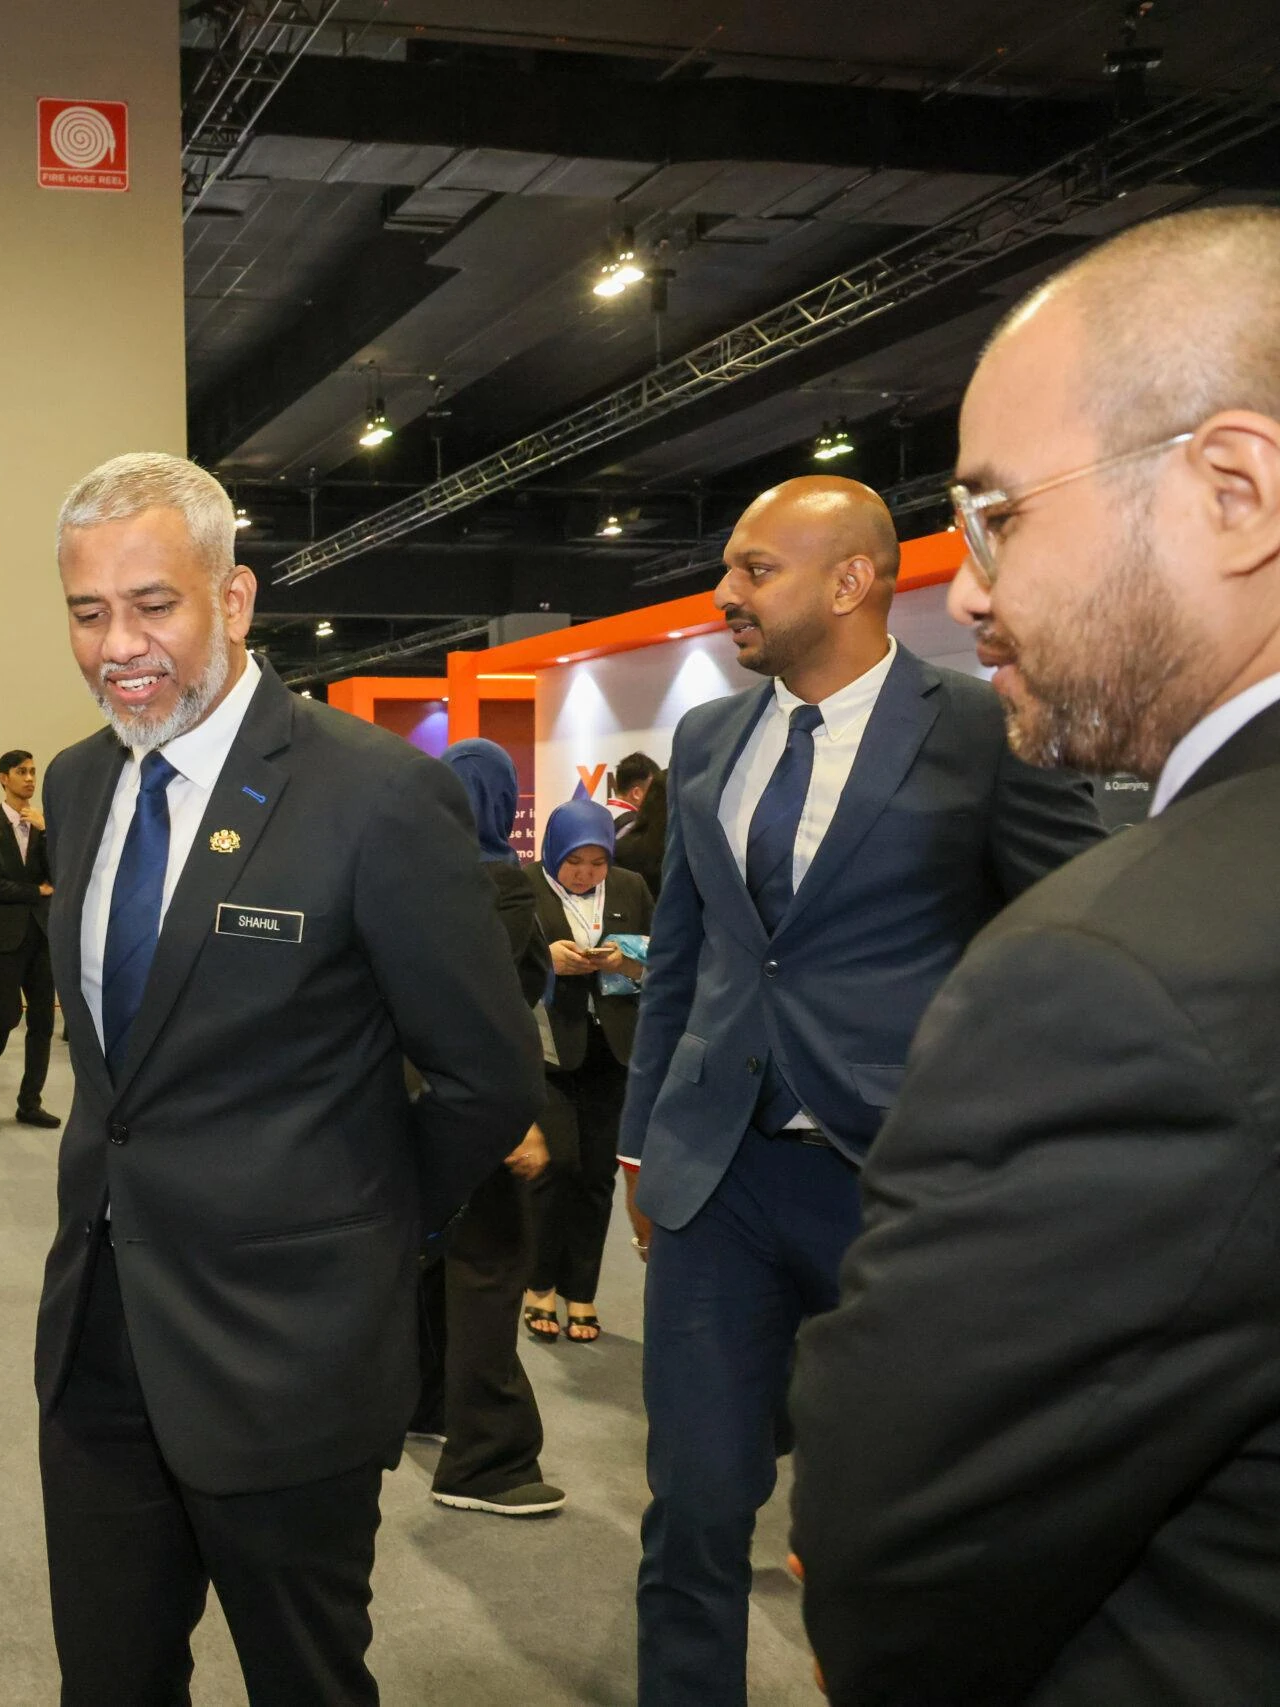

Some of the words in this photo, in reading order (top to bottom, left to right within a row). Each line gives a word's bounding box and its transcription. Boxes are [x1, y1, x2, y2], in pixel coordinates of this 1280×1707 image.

[42, 173, 65, 182] FIRE
[68, 174, 96, 184] HOSE
[99, 176, 125, 186] REEL
[1112, 781, 1150, 792] Quarrying
[238, 915, 281, 932] SHAHUL
